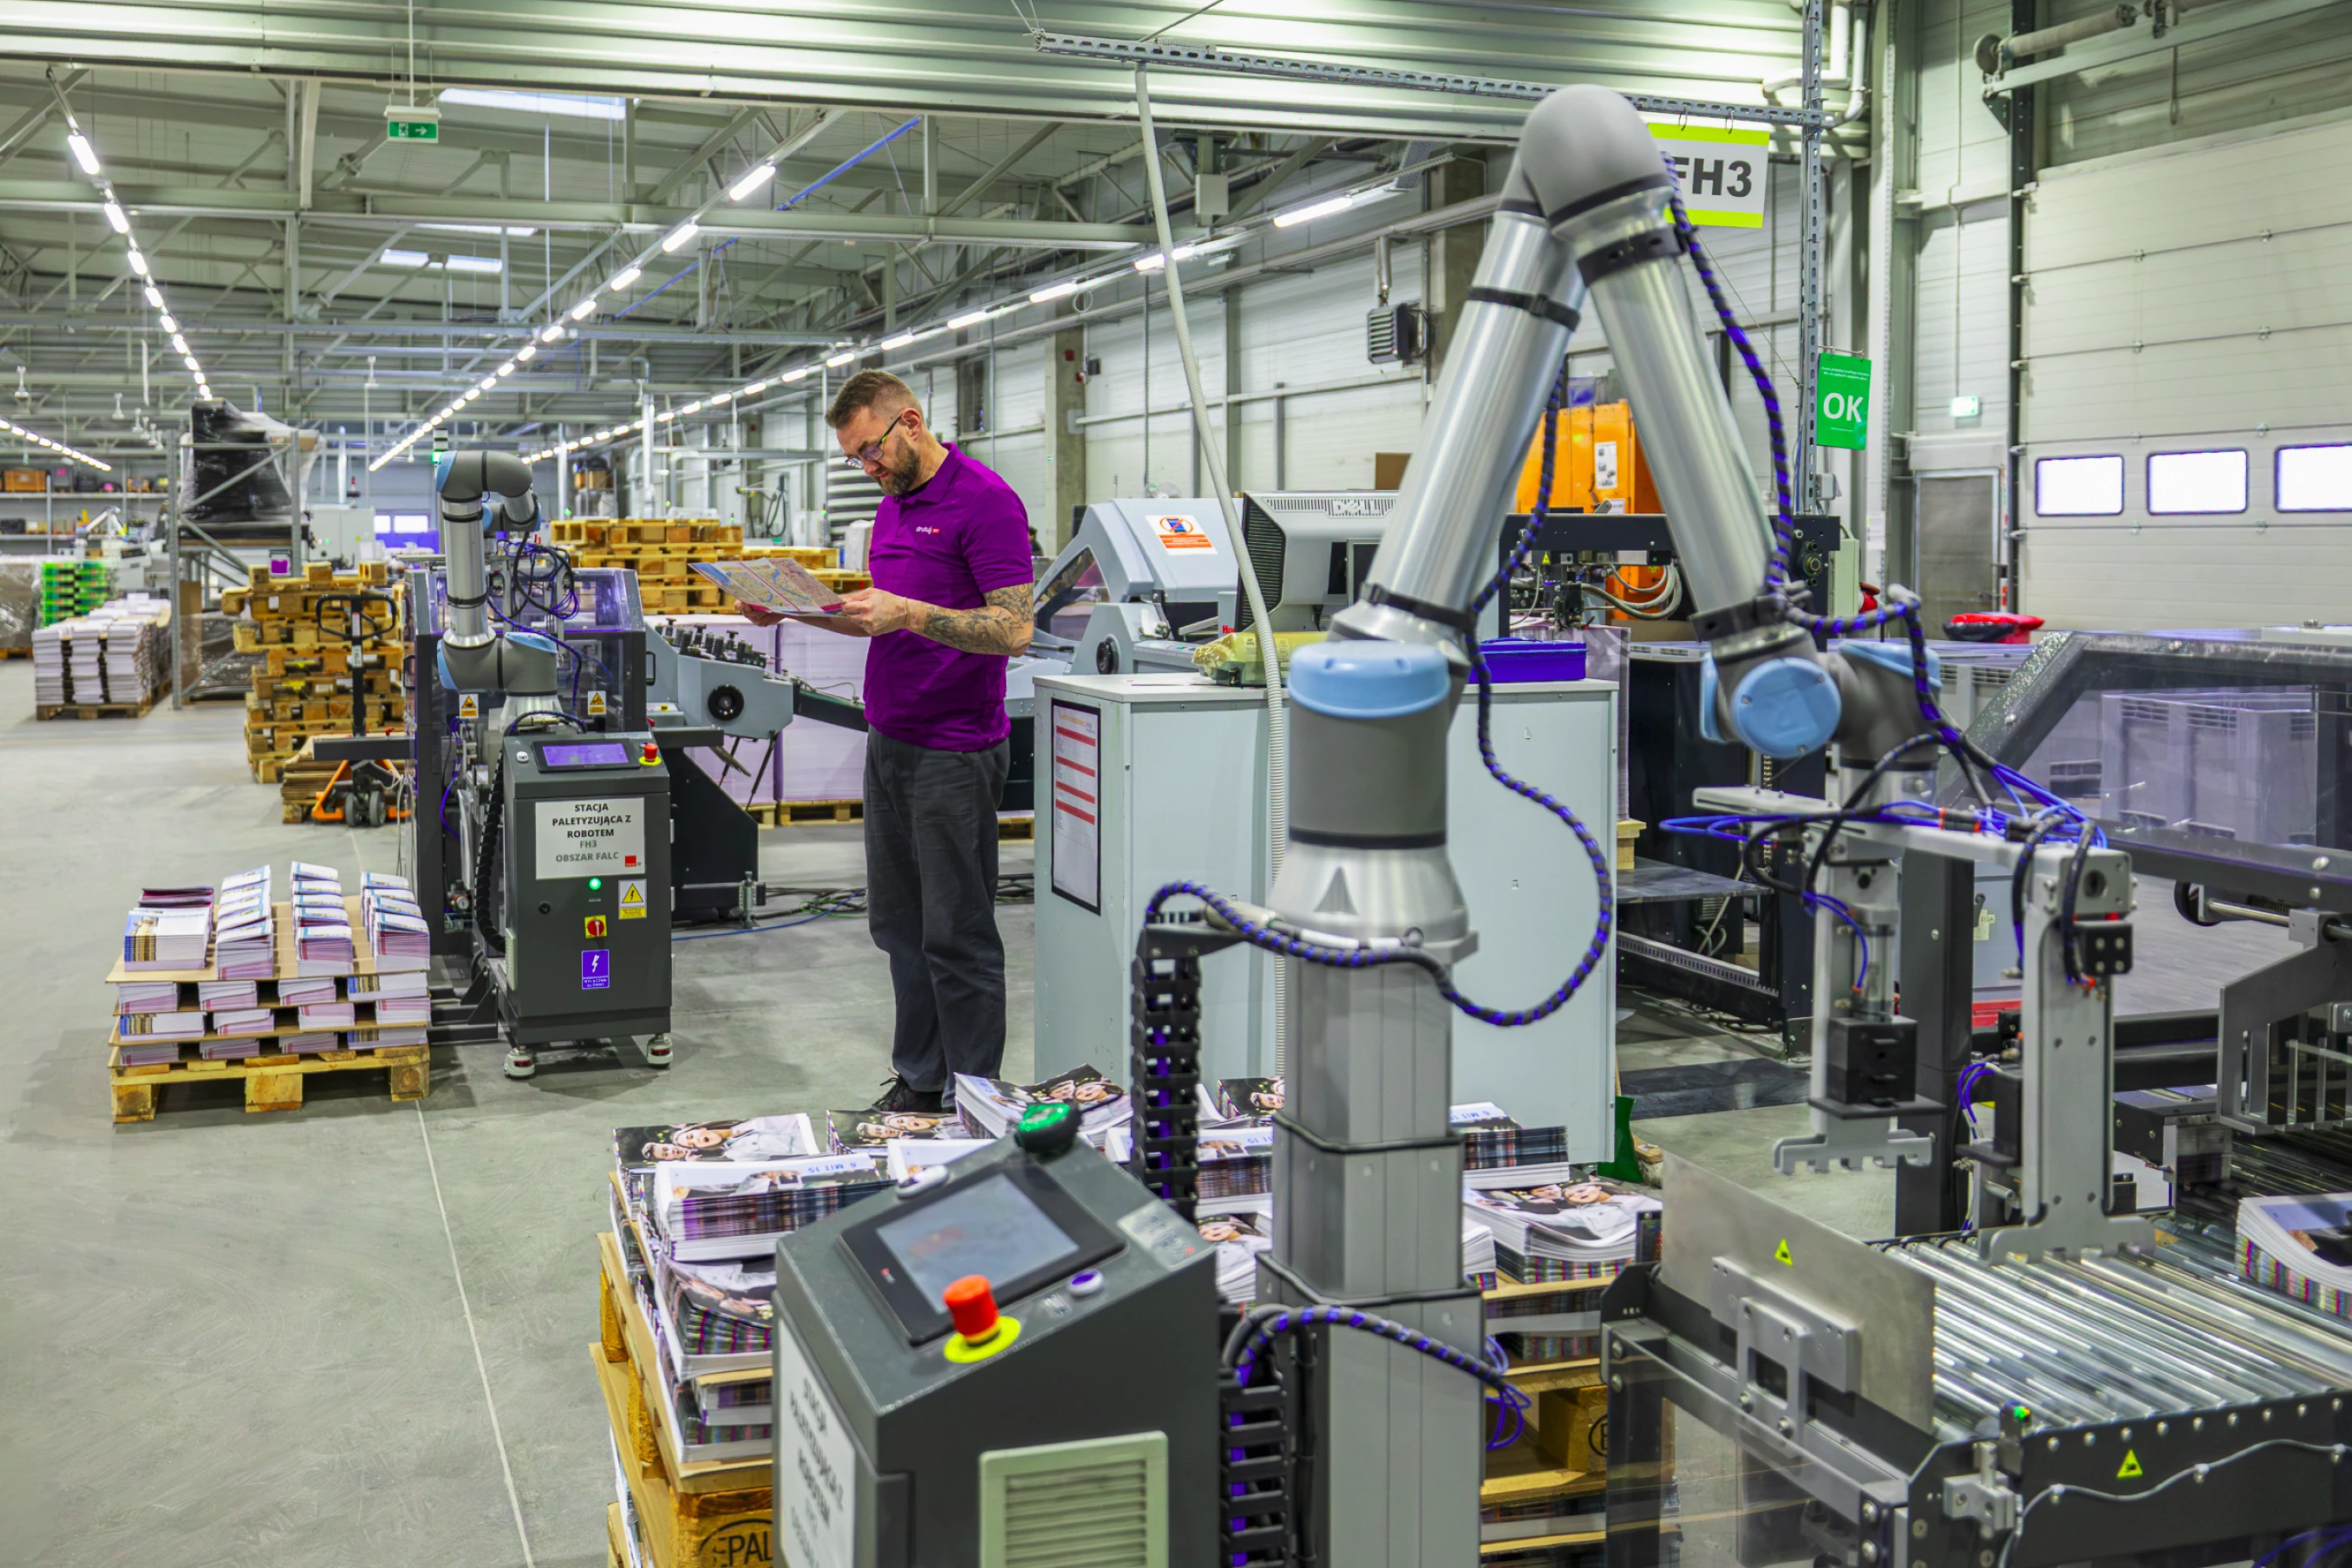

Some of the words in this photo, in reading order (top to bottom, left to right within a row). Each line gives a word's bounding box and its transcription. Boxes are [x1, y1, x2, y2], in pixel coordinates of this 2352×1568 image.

[1823, 392, 1864, 422] OK
[1333, 500, 1382, 516] DELL
[574, 803, 609, 813] STACJA
[552, 815, 623, 826] PALETYZUJĄCA
[567, 829, 614, 839] ROBOTEM
[579, 840, 598, 849] FH3
[556, 853, 593, 862] OBSZAR
[596, 852, 619, 860] FALC
